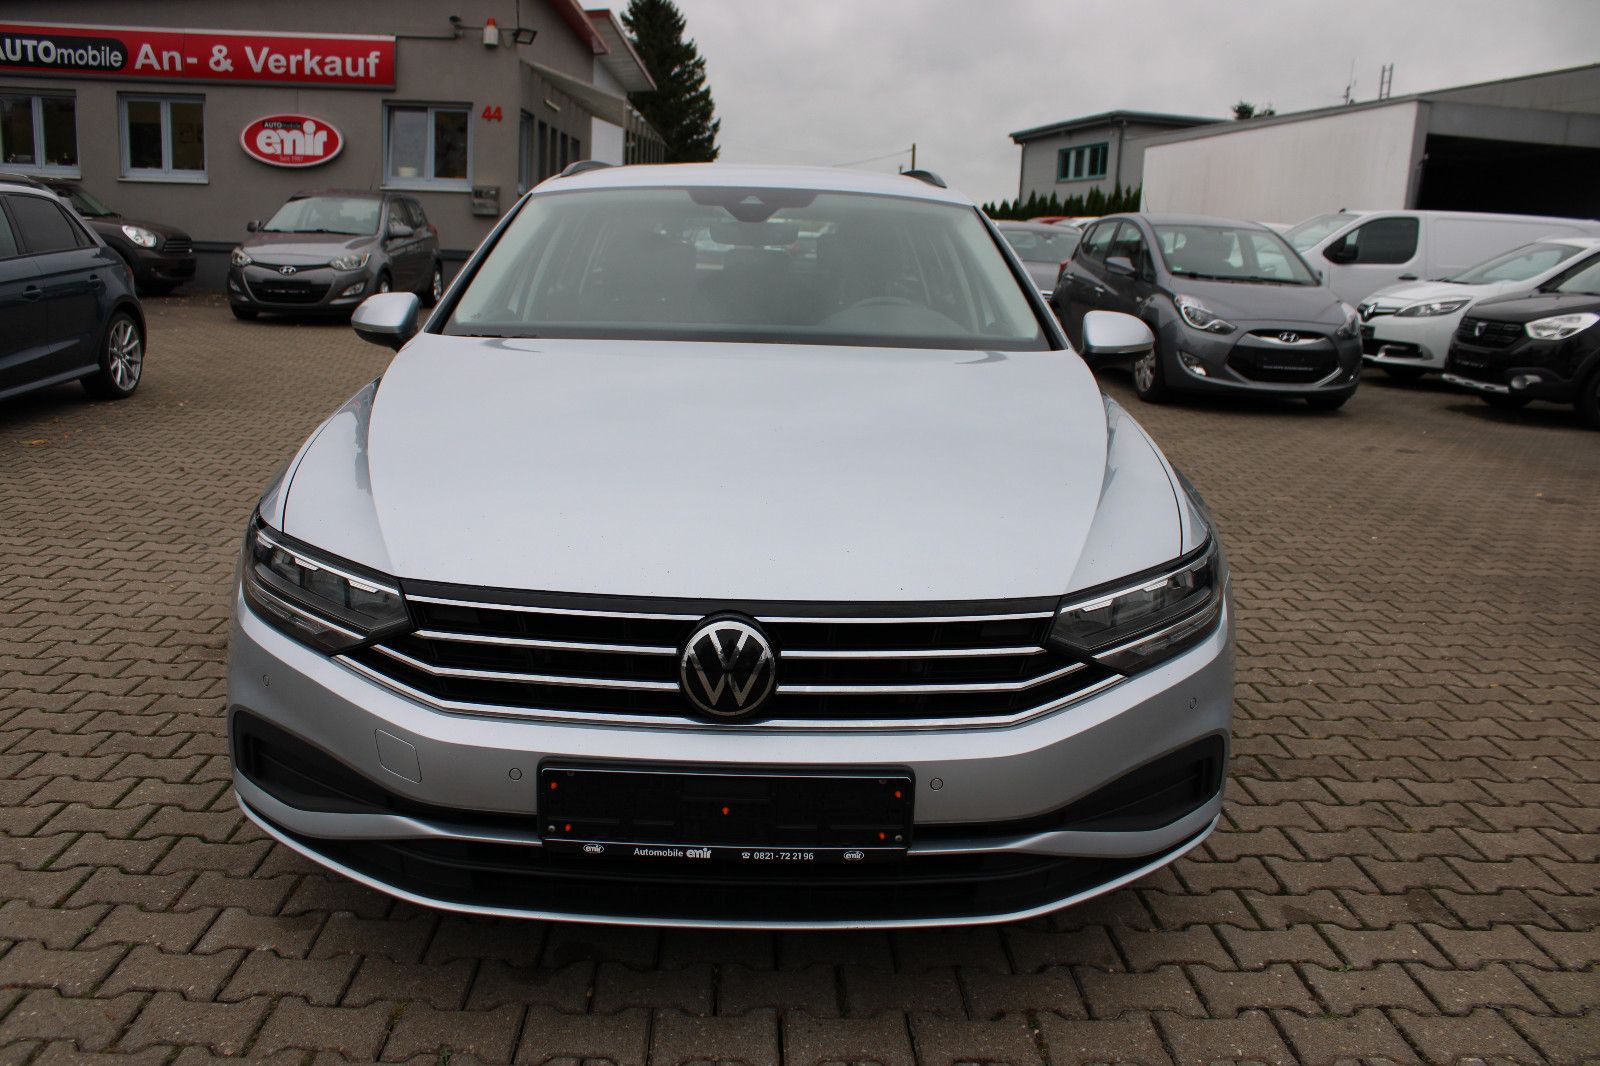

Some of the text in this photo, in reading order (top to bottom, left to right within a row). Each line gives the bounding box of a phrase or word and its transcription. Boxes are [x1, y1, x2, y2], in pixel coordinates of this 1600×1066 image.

[135, 43, 380, 78] An- & Verkauf
[481, 104, 503, 122] 44
[256, 120, 328, 156] emir
[633, 848, 712, 858] Automobile emir
